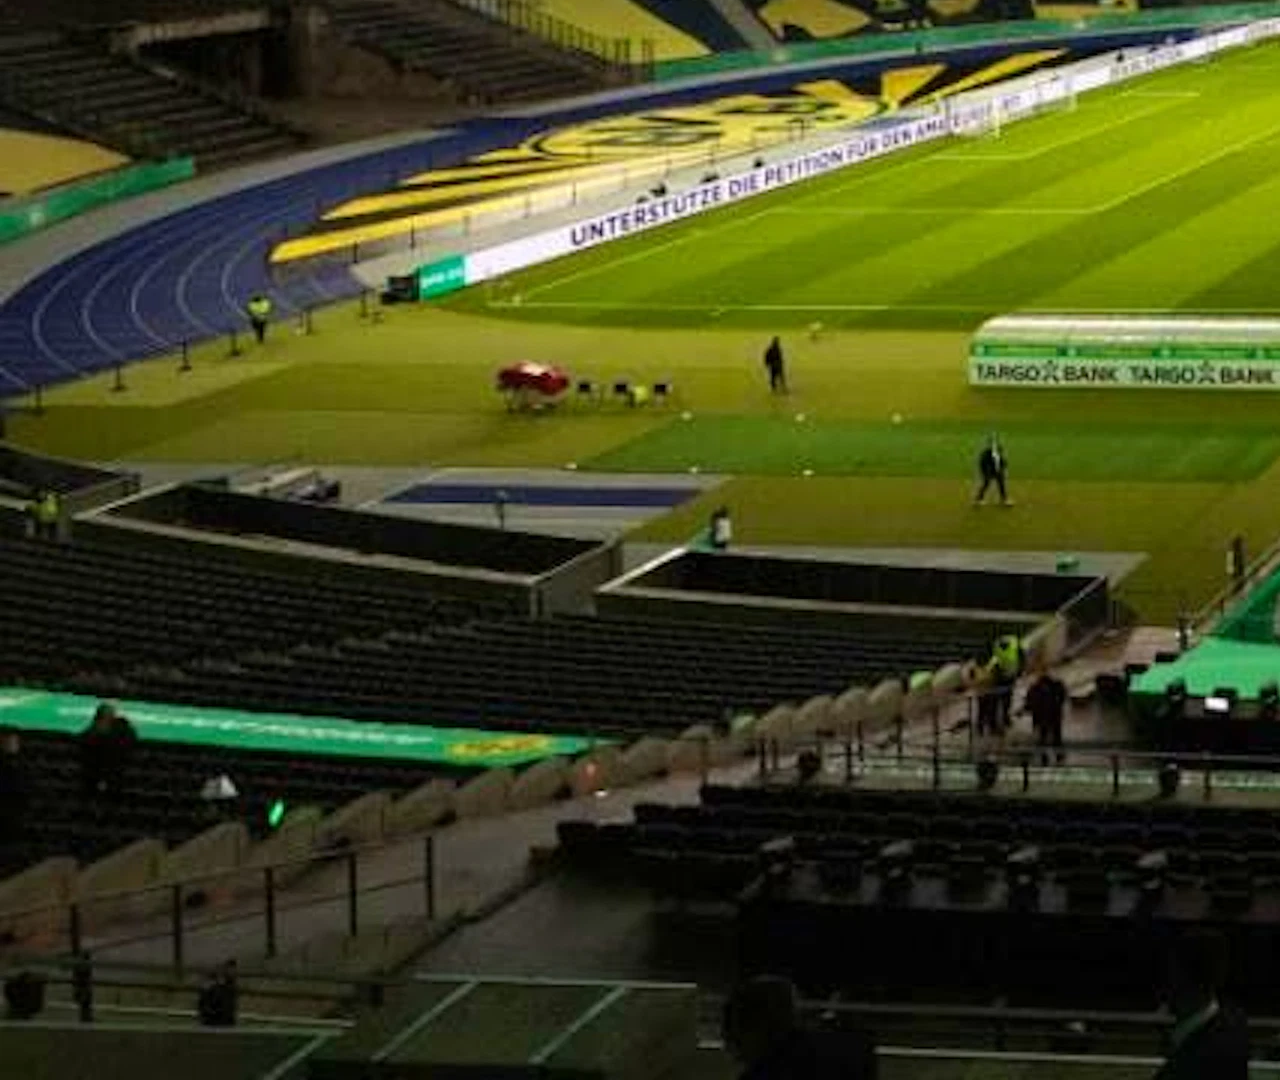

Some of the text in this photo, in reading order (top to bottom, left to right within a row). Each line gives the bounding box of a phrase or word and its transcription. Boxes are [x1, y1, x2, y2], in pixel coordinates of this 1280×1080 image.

[728, 173, 758, 197] DIE
[764, 149, 844, 186] PETITION
[882, 128, 913, 148] DEN
